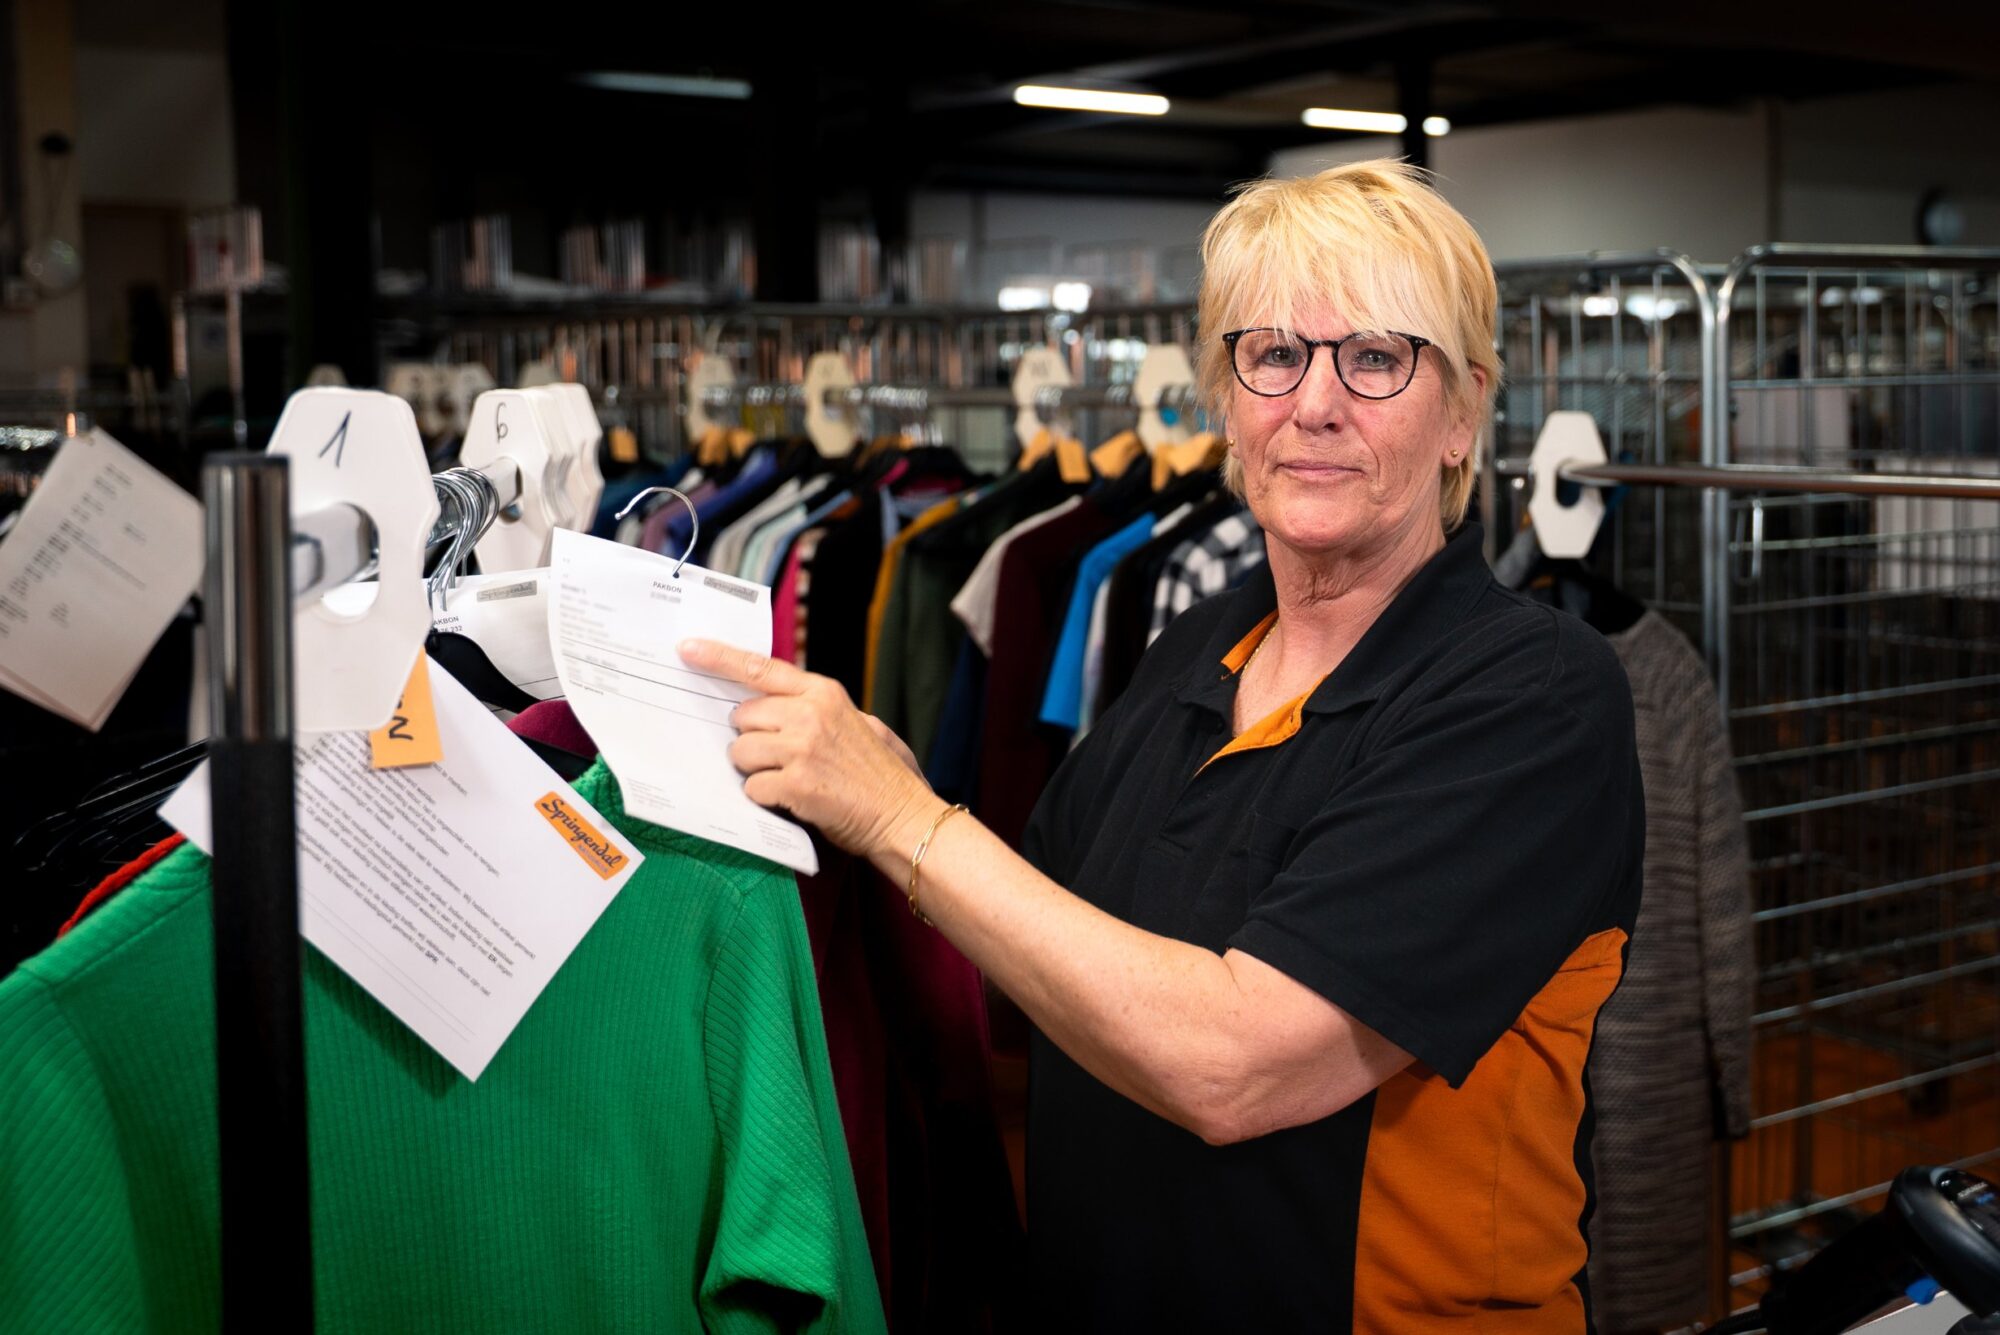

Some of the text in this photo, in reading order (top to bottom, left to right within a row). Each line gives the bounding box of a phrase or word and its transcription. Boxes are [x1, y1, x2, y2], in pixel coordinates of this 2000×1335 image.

[652, 580, 682, 594] PAKBON
[432, 615, 460, 626] AKBON
[541, 799, 623, 868] Springendal
